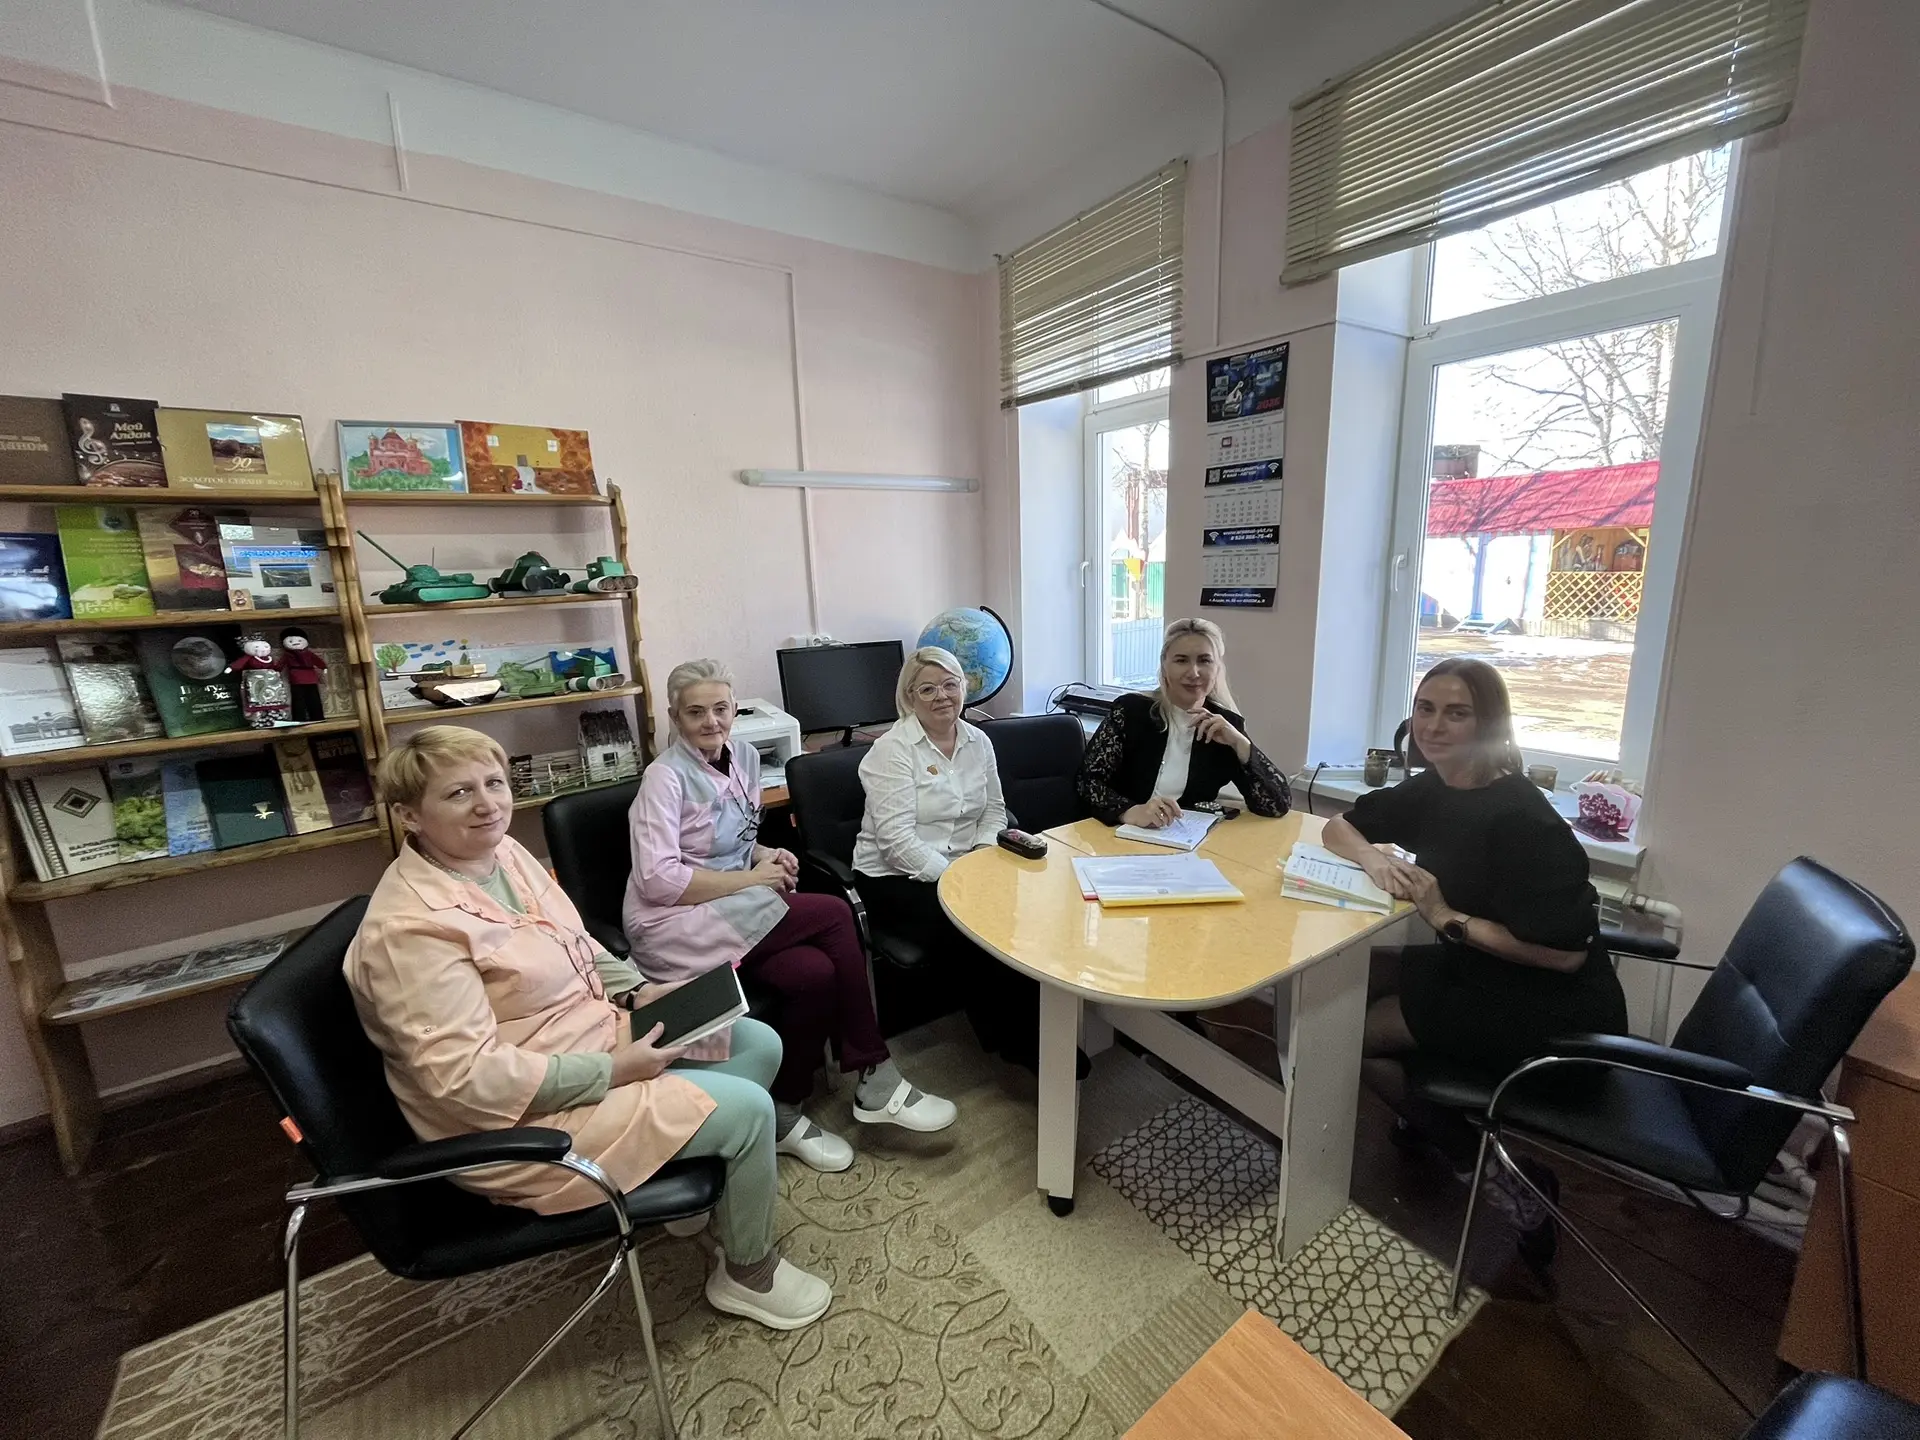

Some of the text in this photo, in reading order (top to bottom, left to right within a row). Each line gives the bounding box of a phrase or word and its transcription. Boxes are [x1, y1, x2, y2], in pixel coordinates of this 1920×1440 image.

[114, 422, 143, 432] Мой
[109, 430, 152, 441] Алдан
[226, 456, 252, 470] 90
